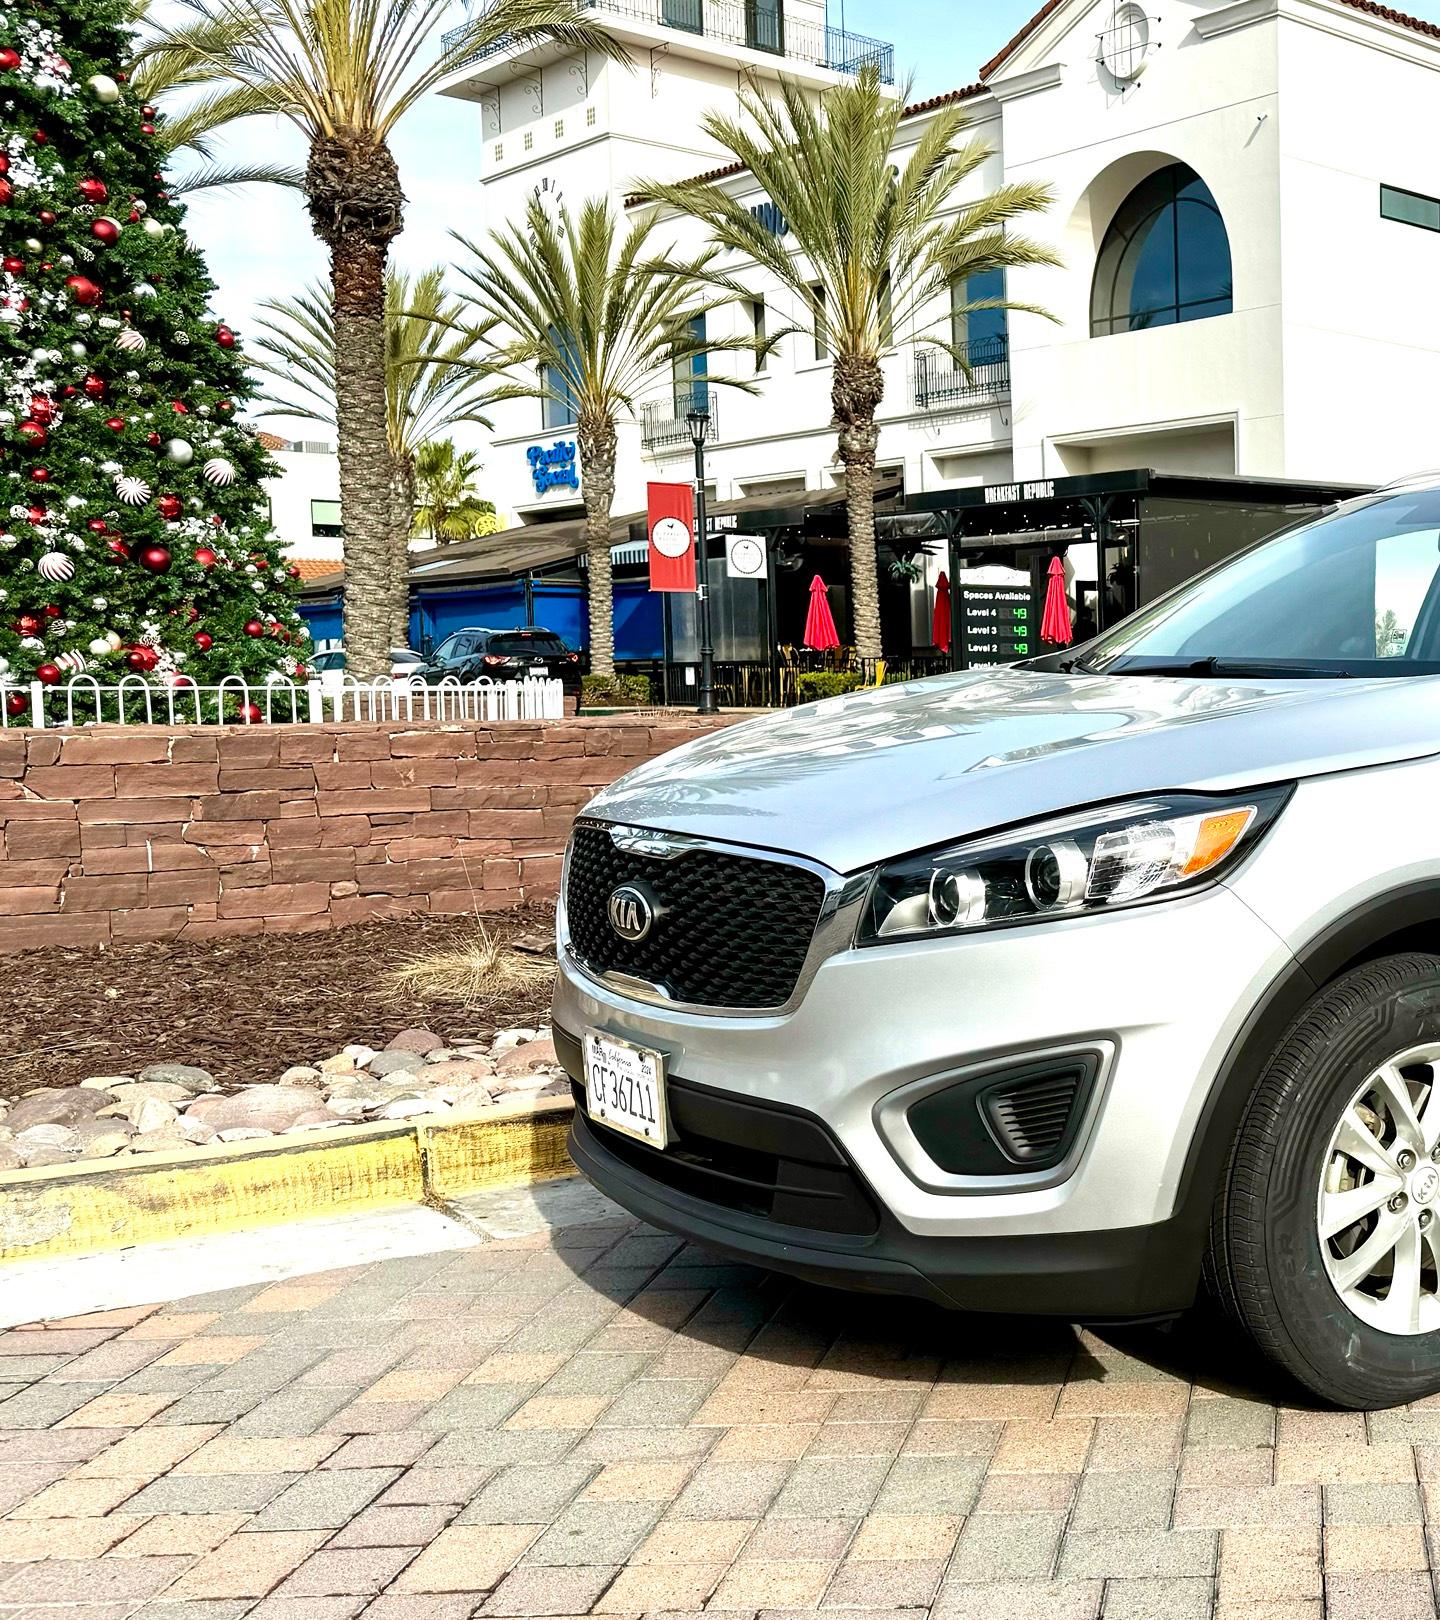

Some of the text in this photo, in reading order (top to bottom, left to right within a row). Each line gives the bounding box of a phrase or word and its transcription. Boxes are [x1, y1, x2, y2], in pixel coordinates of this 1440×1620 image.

[526, 441, 576, 467] Pacific
[532, 462, 579, 493] Social
[984, 480, 1055, 504] BREAKFAST REPUBLIC
[963, 590, 1031, 601] Spaces Available
[966, 607, 1028, 619] Level 4 49
[967, 625, 1028, 637] Level 3 49
[968, 643, 1028, 655] Level 2 49
[610, 896, 640, 930] KIA
[592, 1063, 656, 1124] CF36Z11
